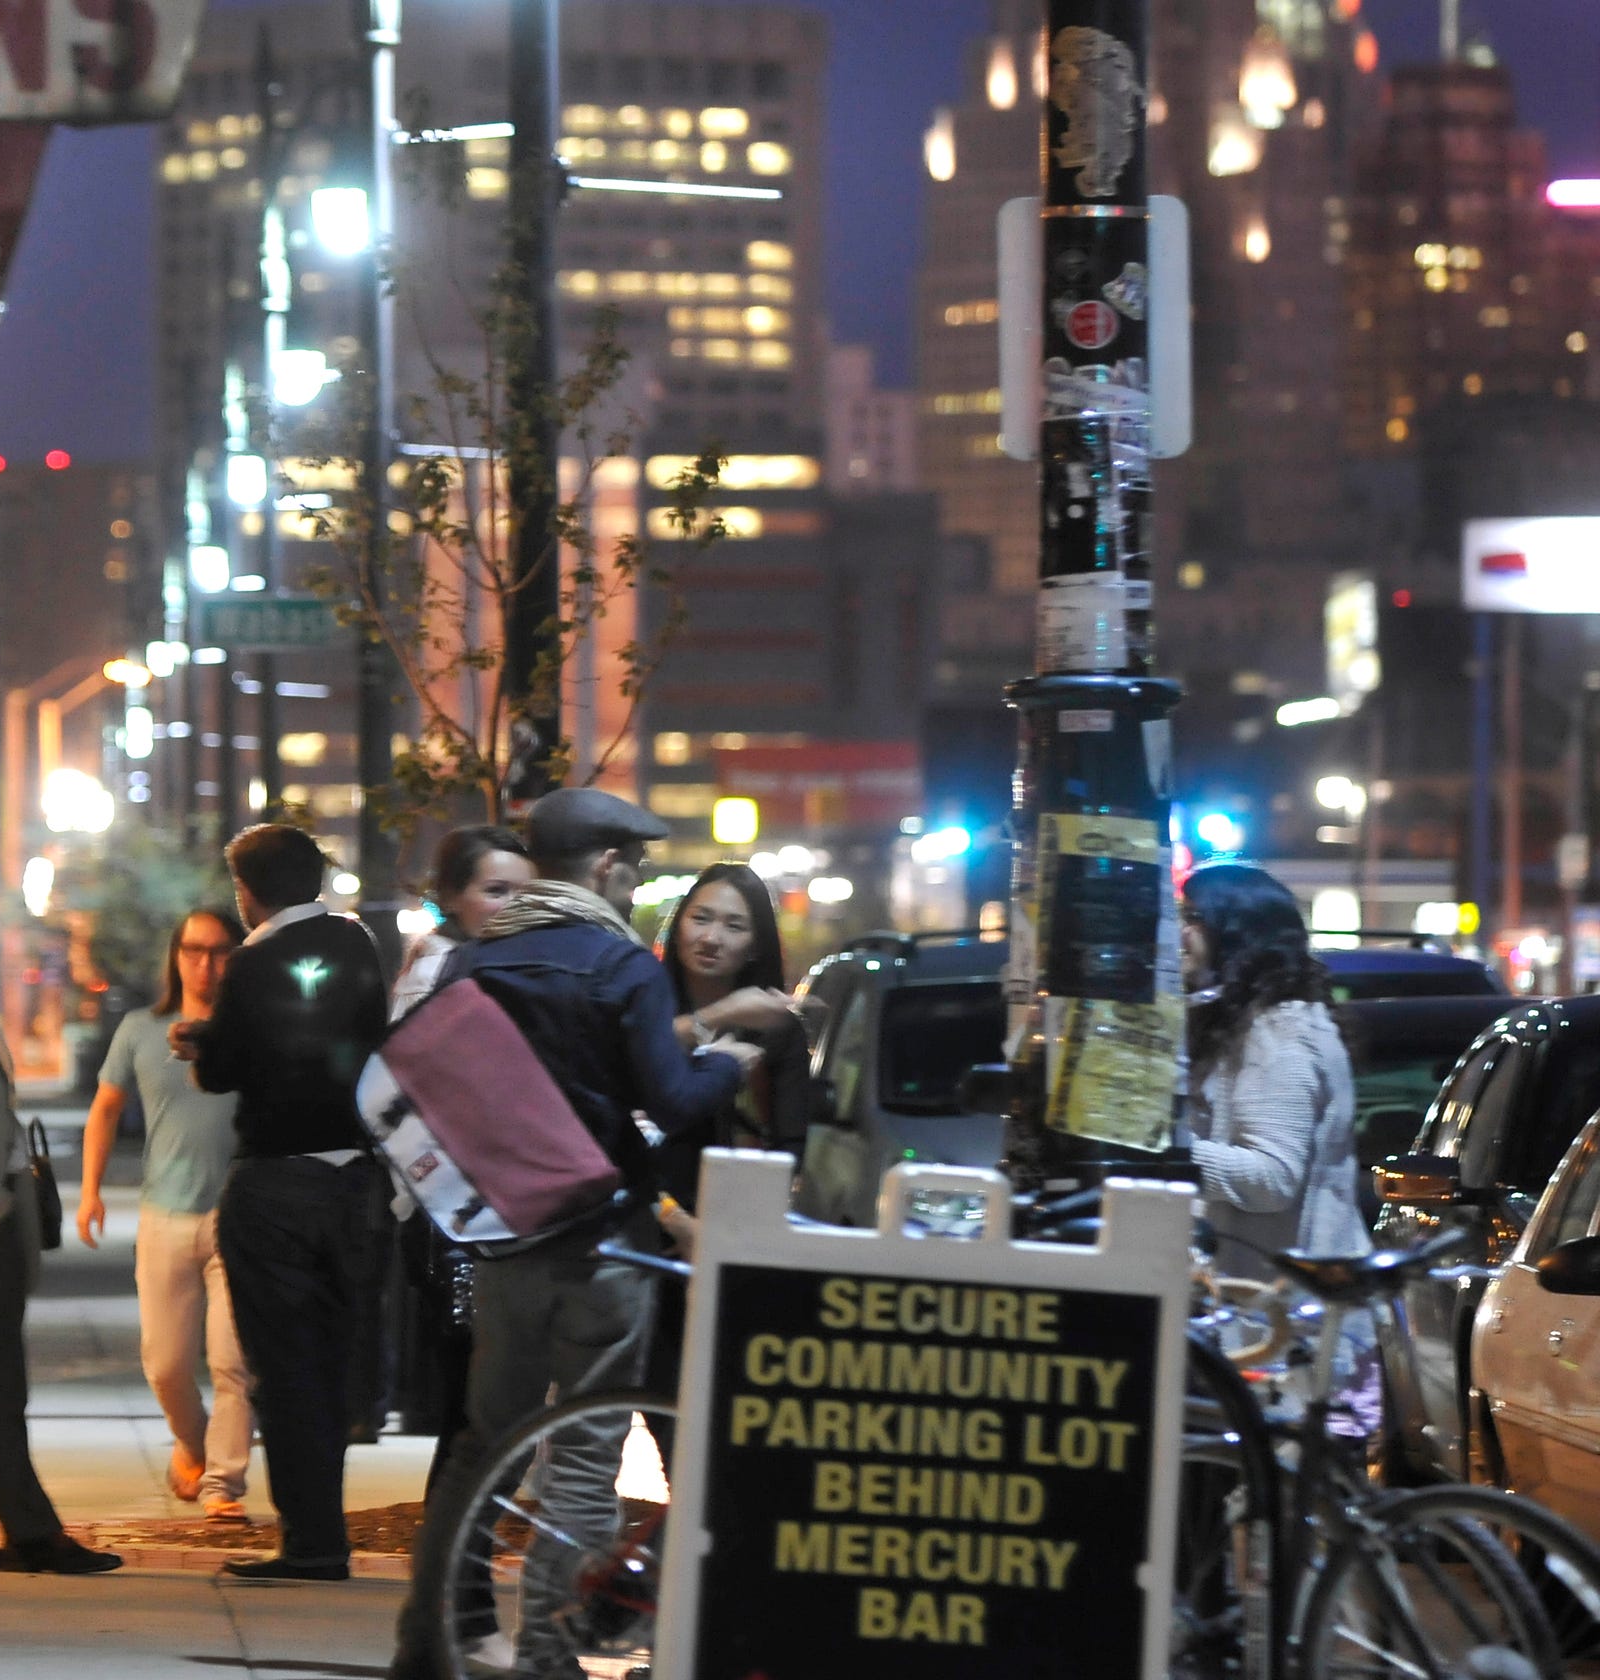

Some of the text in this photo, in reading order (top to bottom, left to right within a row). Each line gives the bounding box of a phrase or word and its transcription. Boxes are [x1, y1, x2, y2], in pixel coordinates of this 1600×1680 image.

[820, 1279, 1059, 1342] SECURE
[745, 1335, 1128, 1409] COMMUNITY
[730, 1396, 1137, 1472] PARKING LOT
[813, 1462, 1044, 1525] BEHIND
[775, 1522, 1077, 1590] MERCURY
[858, 1588, 986, 1644] BAR
